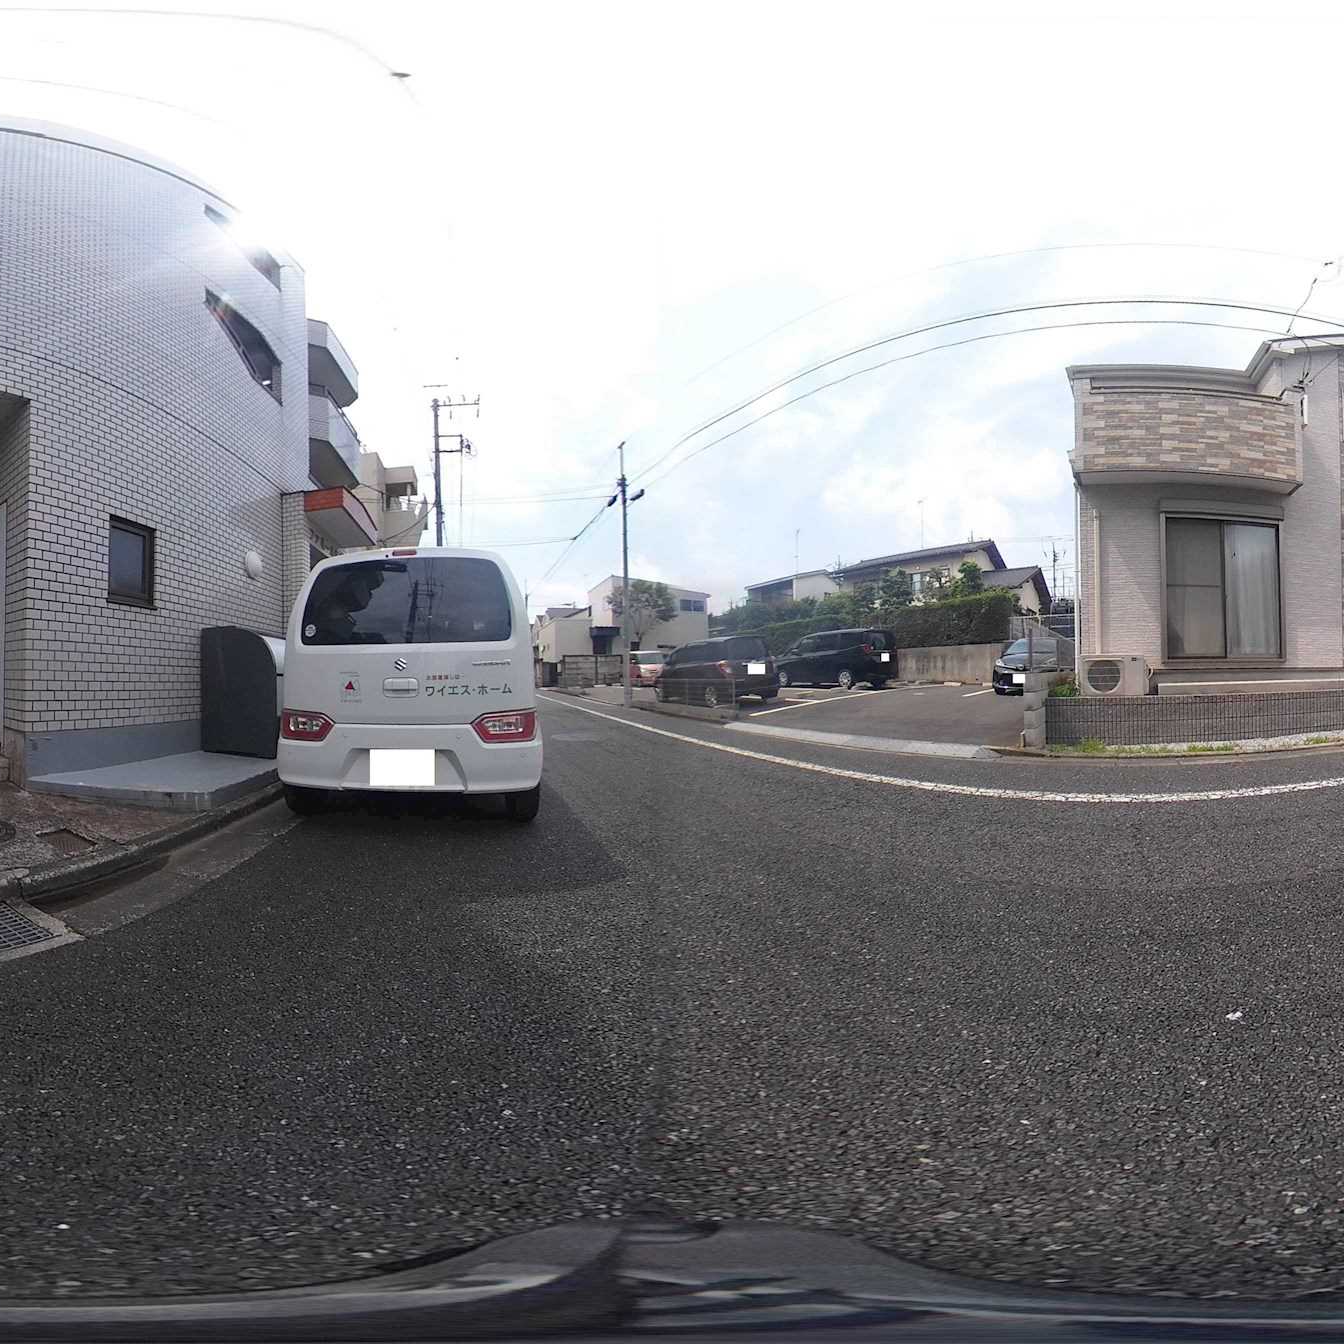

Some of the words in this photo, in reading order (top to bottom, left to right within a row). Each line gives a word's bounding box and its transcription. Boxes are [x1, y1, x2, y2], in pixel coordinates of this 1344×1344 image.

[425, 683, 513, 697] ワイエス・ホーム
